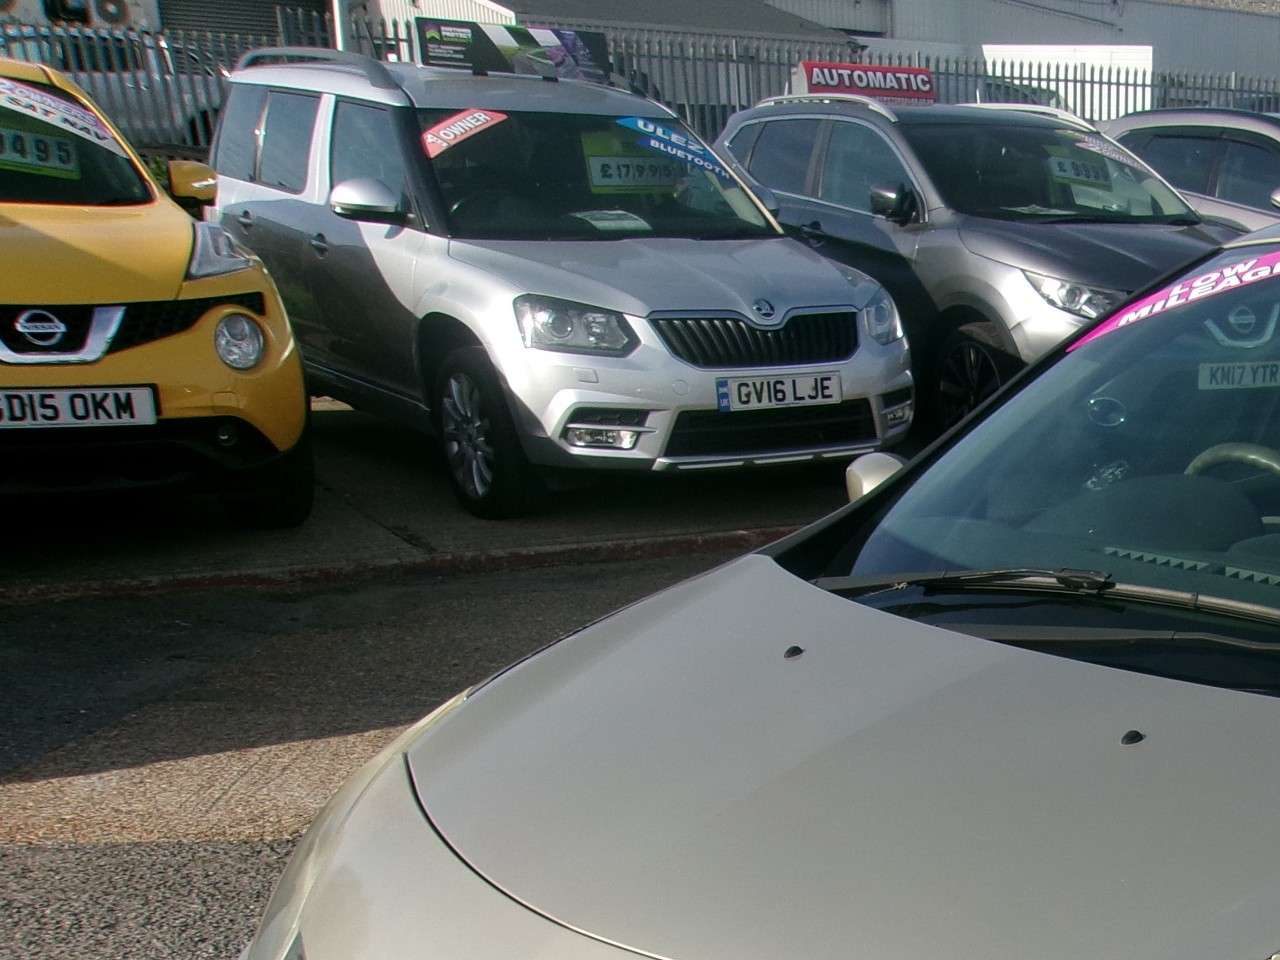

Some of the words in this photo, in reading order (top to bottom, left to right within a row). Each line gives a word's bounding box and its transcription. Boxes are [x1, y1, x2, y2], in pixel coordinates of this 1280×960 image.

[811, 67, 931, 92] AUTOMATIC
[439, 111, 492, 141] OWNER
[636, 118, 705, 156] ULEZ
[649, 138, 731, 180] BLUETOOTH
[1170, 257, 1260, 293] LOW
[1209, 364, 1248, 386] KM17
[1250, 363, 1280, 385] YTR
[737, 380, 786, 405] GV16
[791, 377, 833, 401] LJE
